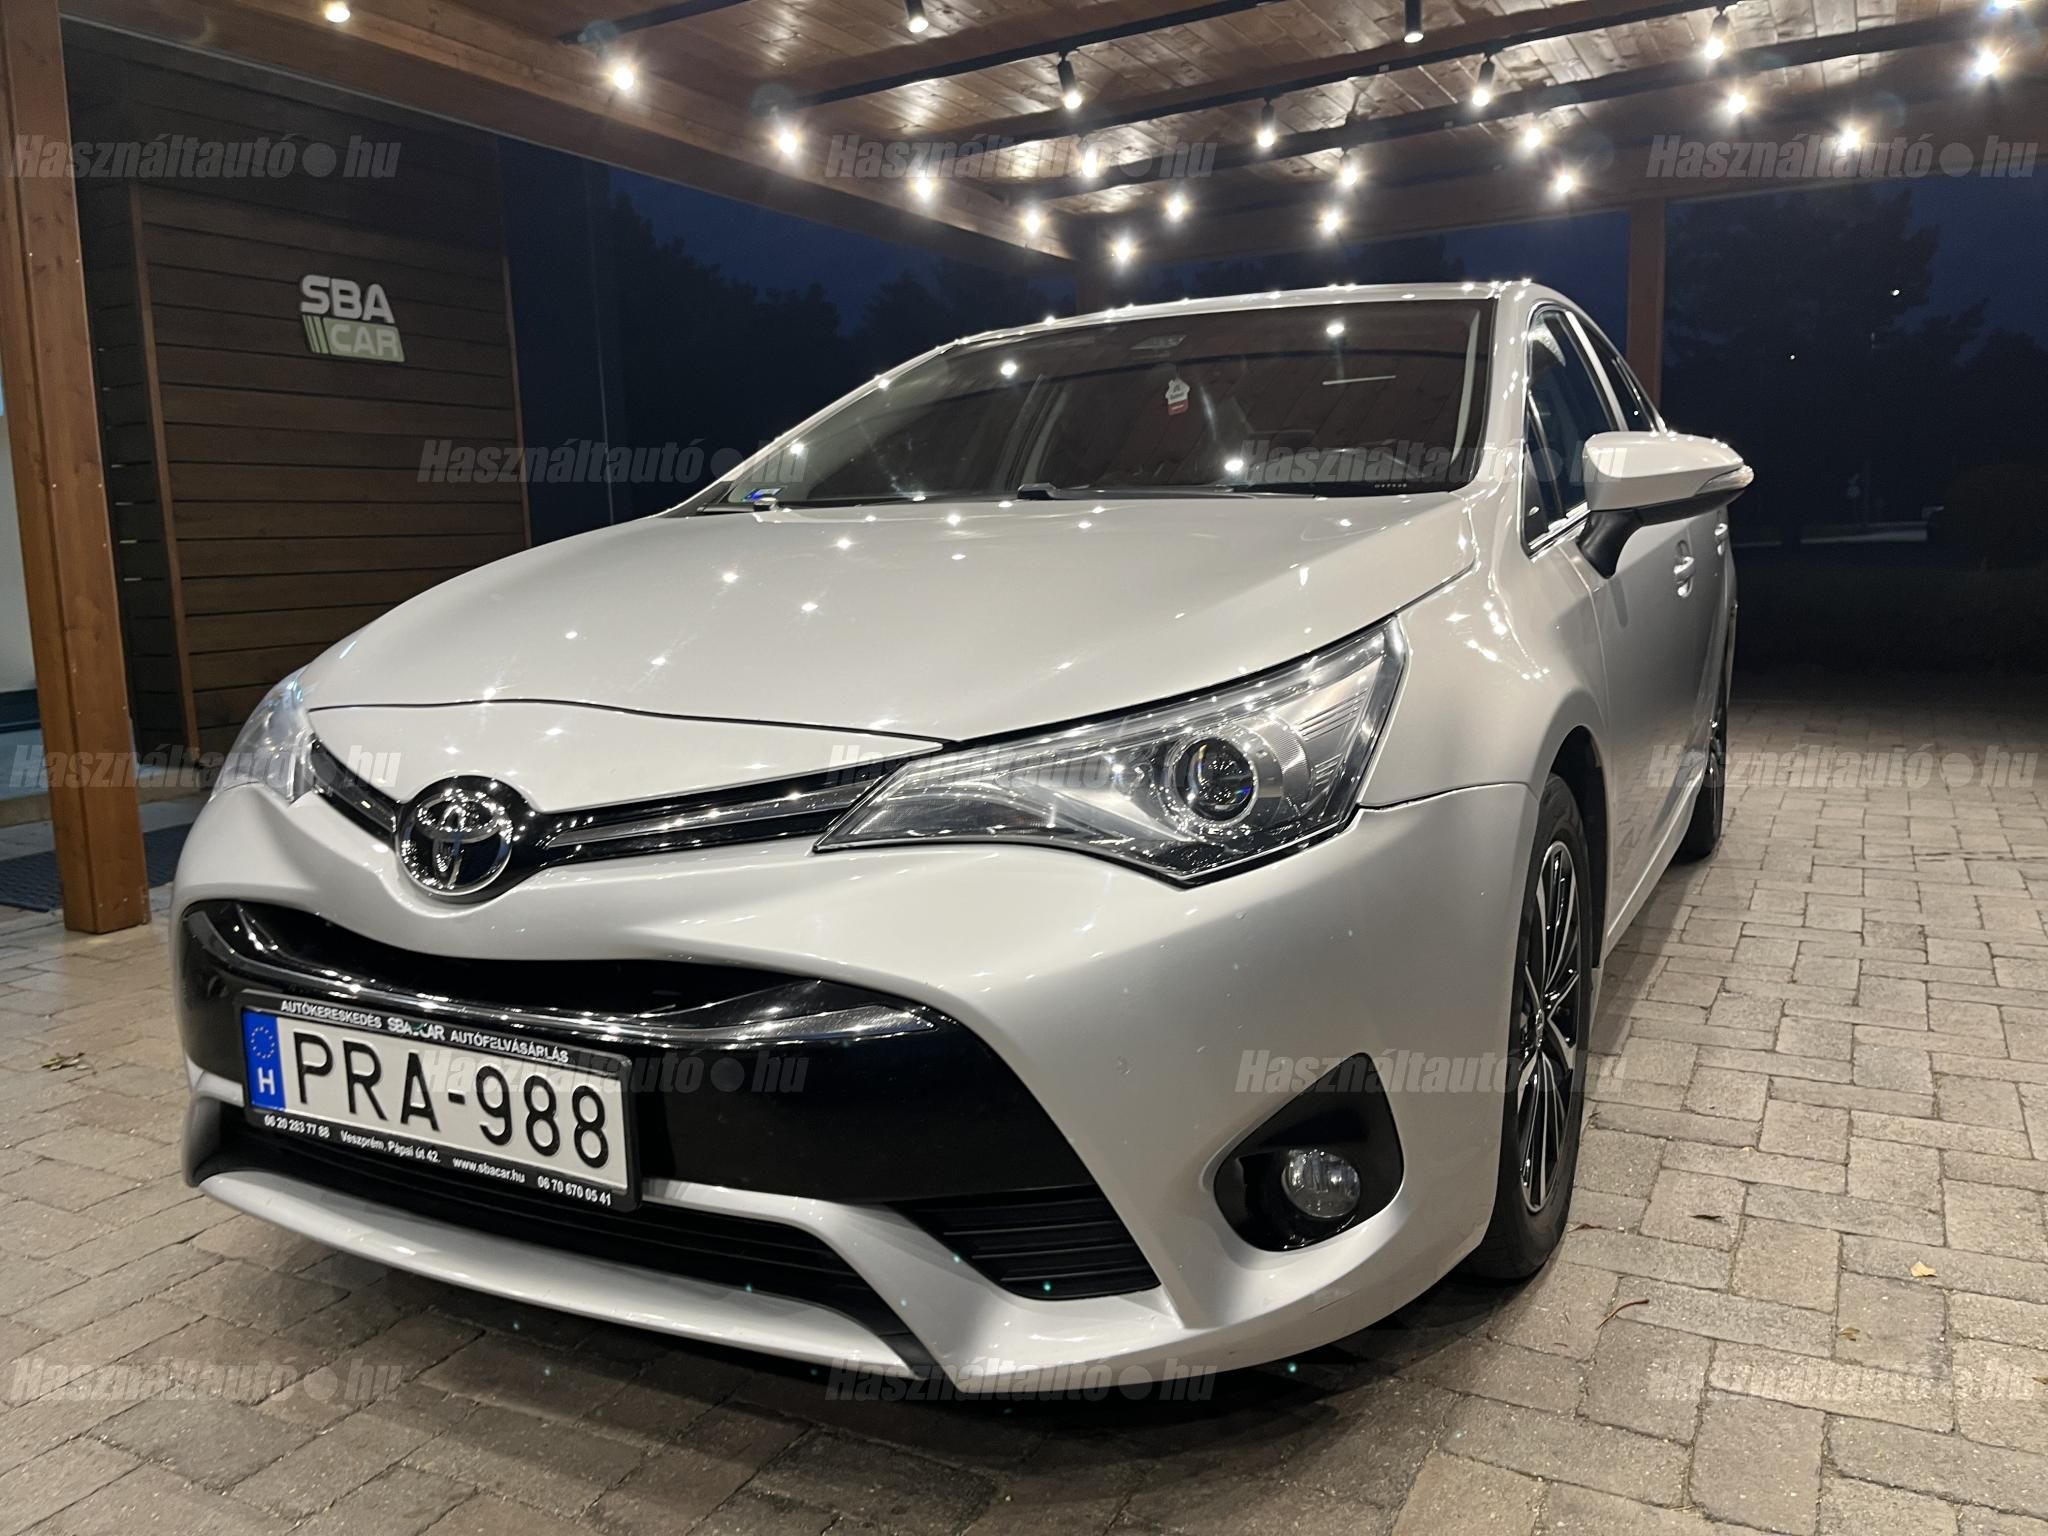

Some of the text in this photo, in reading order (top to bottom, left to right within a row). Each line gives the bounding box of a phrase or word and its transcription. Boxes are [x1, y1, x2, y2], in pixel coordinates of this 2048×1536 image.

[301, 274, 395, 324] SBA
[330, 323, 399, 359] CAR
[281, 1000, 382, 1029] AUTÓKERESKEDÉS
[450, 1030, 569, 1063] AUTÓFELVÁSÁRLÁS
[257, 1066, 276, 1096] H
[293, 1031, 609, 1168] PRA-988
[599, 1191, 612, 1206] 41
